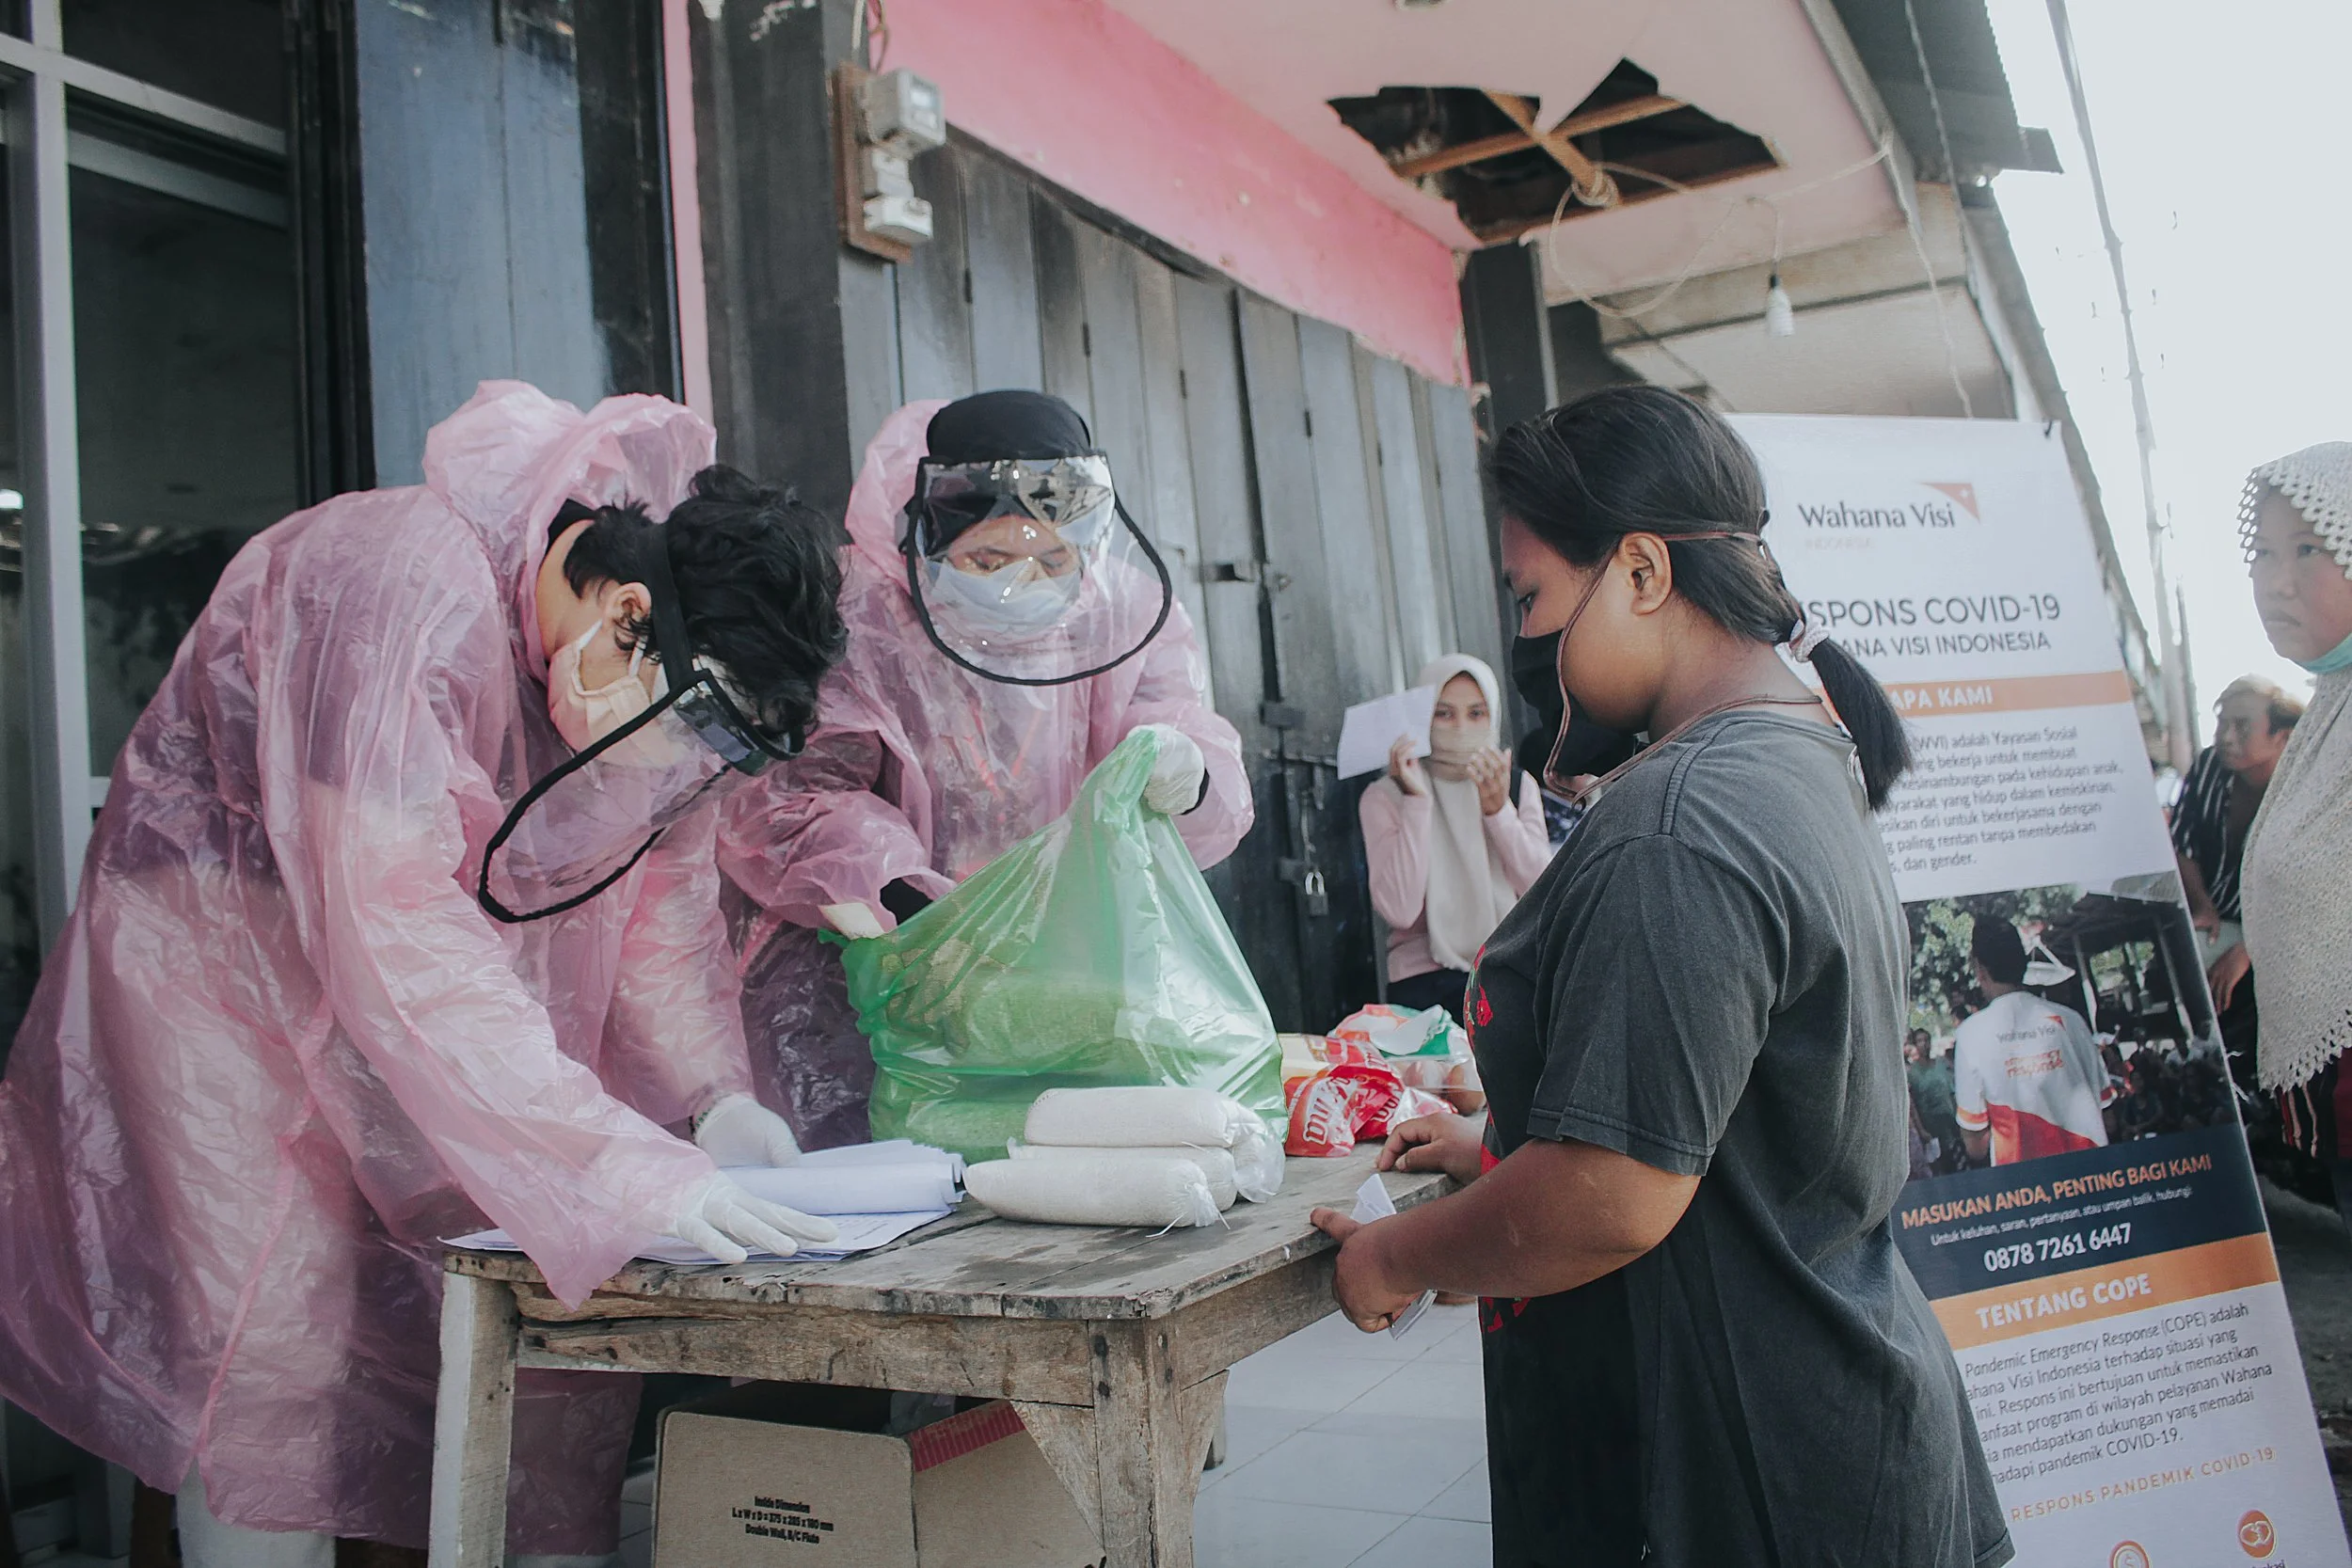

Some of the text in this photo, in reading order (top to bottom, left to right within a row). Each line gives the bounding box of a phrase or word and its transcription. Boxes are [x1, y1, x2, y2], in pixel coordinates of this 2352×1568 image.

[1797, 500, 1956, 529] Wahana Visi
[1801, 594, 2061, 628] SPONS COVID-19
[1840, 631, 2052, 657] ANA VISI INDONESIA
[1938, 685, 1994, 707] KAMI
[1936, 752, 1981, 769] bekerja
[1985, 749, 2017, 766] untuk
[2023, 746, 2077, 761] membuat
[1951, 732, 1990, 749] adalah
[1997, 768, 2026, 784] pada
[1920, 813, 1941, 829] diri
[1944, 809, 1978, 827] untuk
[2058, 801, 2102, 816] dengan
[1941, 794, 1971, 811] yang
[1972, 788, 2007, 806] hidup
[2010, 786, 2045, 801] dalam
[1897, 834, 1935, 852] paling
[1938, 832, 1978, 847] rentan
[1980, 829, 2014, 844] tanpa
[2018, 820, 2096, 838] membedakan
[1903, 856, 1927, 871] dan
[1930, 850, 1978, 871] gender.
[1900, 1153, 2213, 1229] MASUKAN ANDA, PENTING BAGI KAMI
[1931, 1230, 1960, 1246] Untuk
[1960, 1224, 2000, 1240] keluhan,
[2000, 1218, 2029, 1233] saran,
[2083, 1204, 2102, 1216] atau
[2103, 1196, 2132, 1212] umpan
[1983, 1223, 2132, 1273] 0878 7261 6447
[1976, 1273, 2153, 1330] TENTANG COPE
[1964, 1302, 2249, 1378] Pandemic Emergency Response (COPE) adalah
[1966, 1328, 2238, 1401] ahana Visi Indonesia terhadap situasi yang
[1998, 1392, 2057, 1416] Respons
[2058, 1382, 2076, 1402] ini
[2078, 1370, 2145, 1396] bertujuan
[2148, 1360, 2183, 1382] untuk
[2185, 1345, 2259, 1371] memastikan
[1980, 1364, 2273, 1443] anfaat program di wilayah pelayanan Wahana
[2002, 1428, 2093, 1460] mendapatkan
[2096, 1411, 2164, 1437] dukungan
[2166, 1403, 2199, 1424] yang
[2199, 1386, 2255, 1413] memadai
[2038, 1446, 2104, 1476] pandemik
[2106, 1426, 2185, 1457] COVID-19.
[2010, 1447, 2275, 1522] RESPONS PANDEMIK COVID-19
